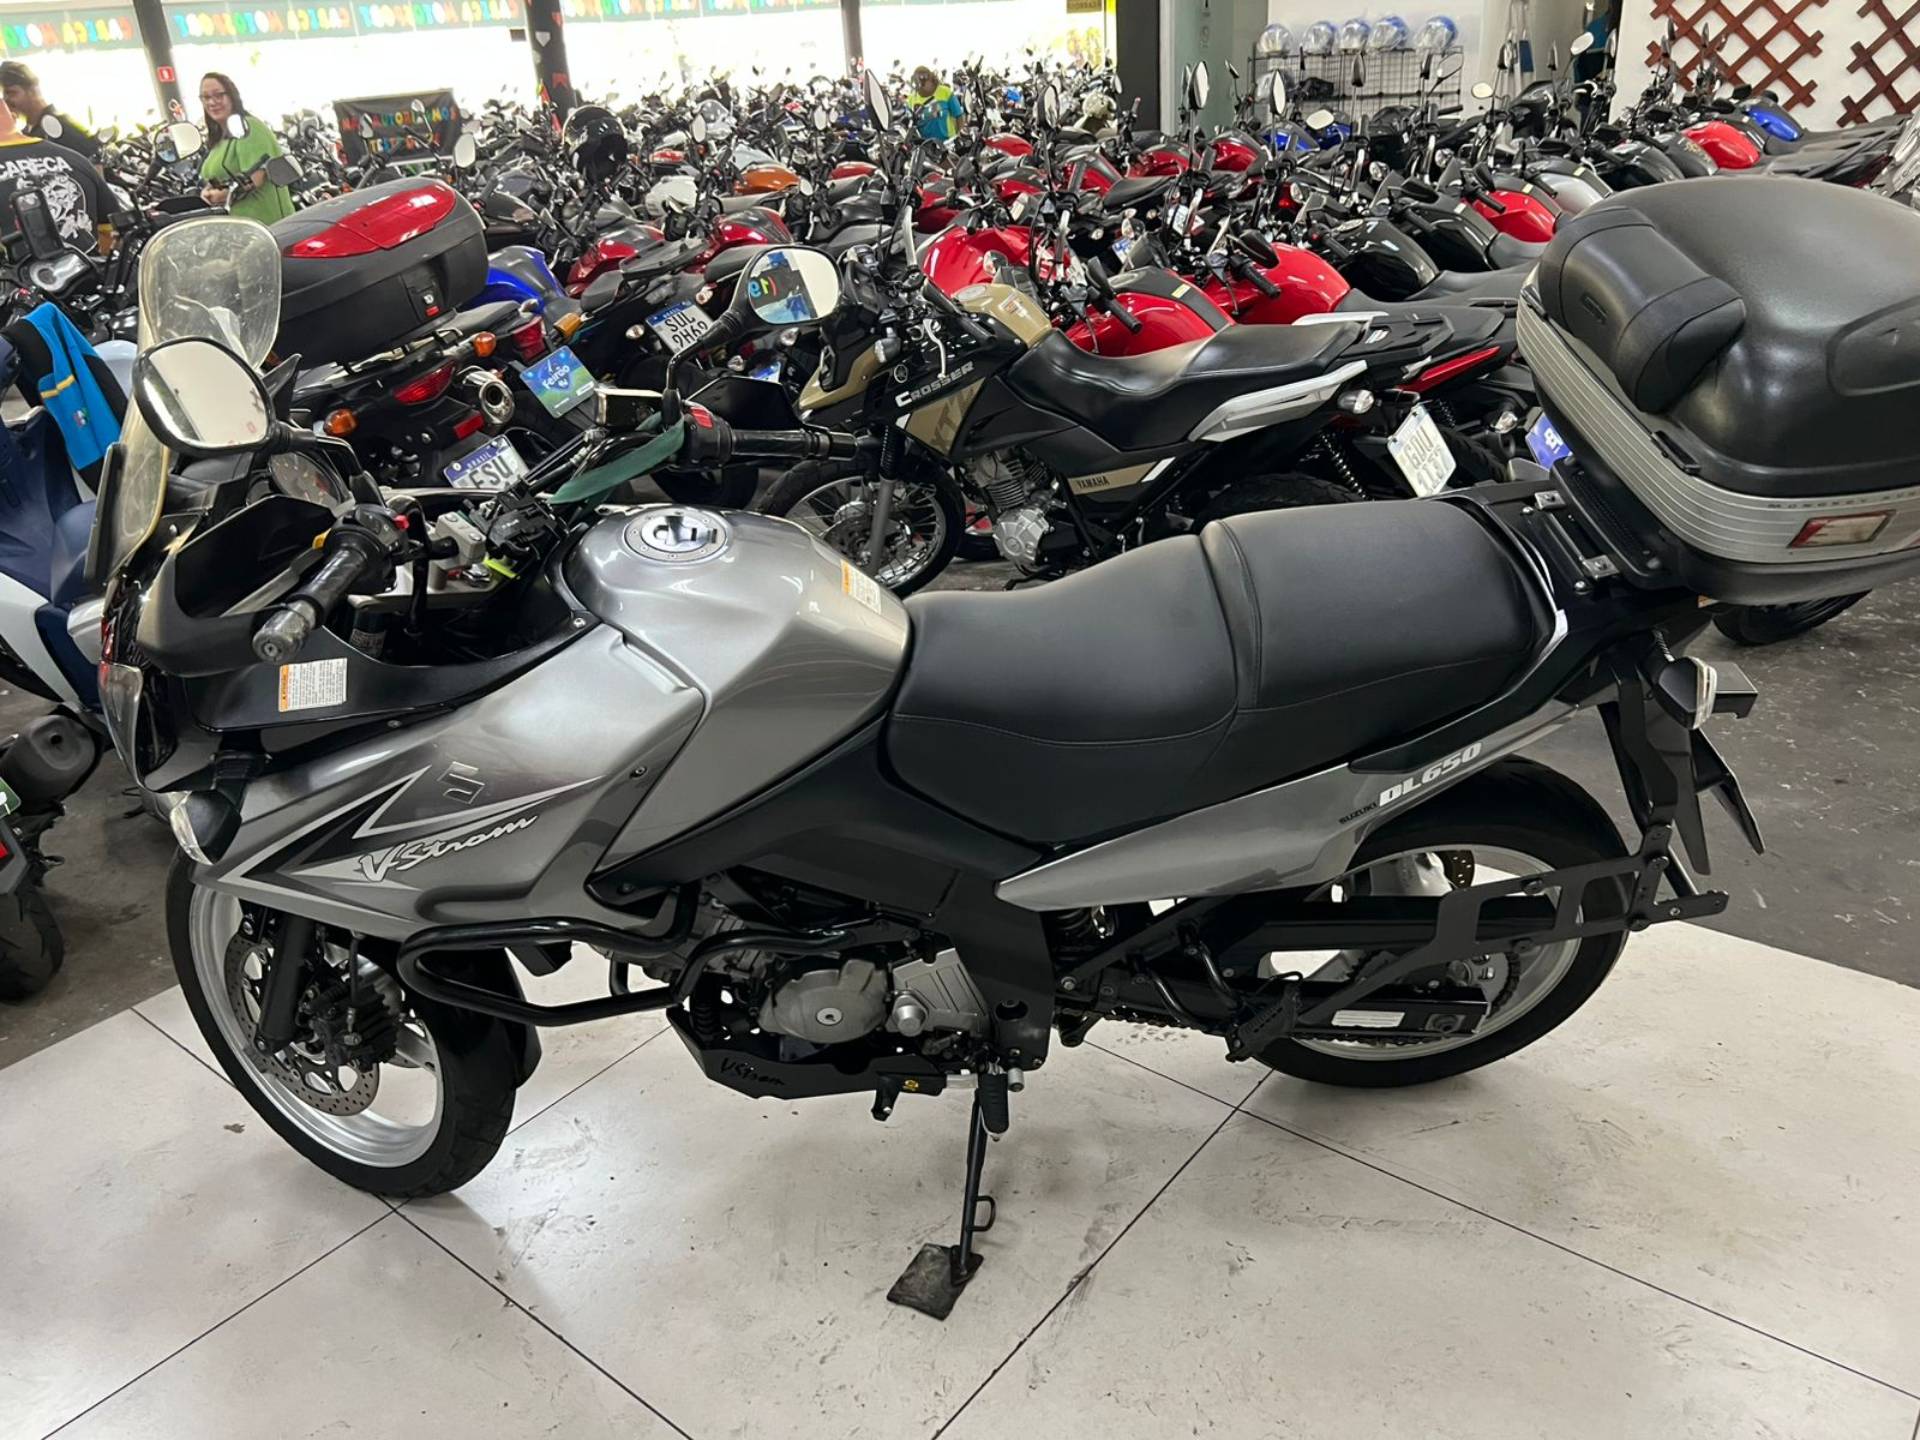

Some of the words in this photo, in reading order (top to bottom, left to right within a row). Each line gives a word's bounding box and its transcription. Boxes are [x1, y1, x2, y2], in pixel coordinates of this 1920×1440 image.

[894, 361, 975, 408] CROSSER
[1076, 475, 1111, 489] YAMAHA
[1339, 801, 1378, 824] SUZUKI
[1379, 741, 1482, 807] DL650
